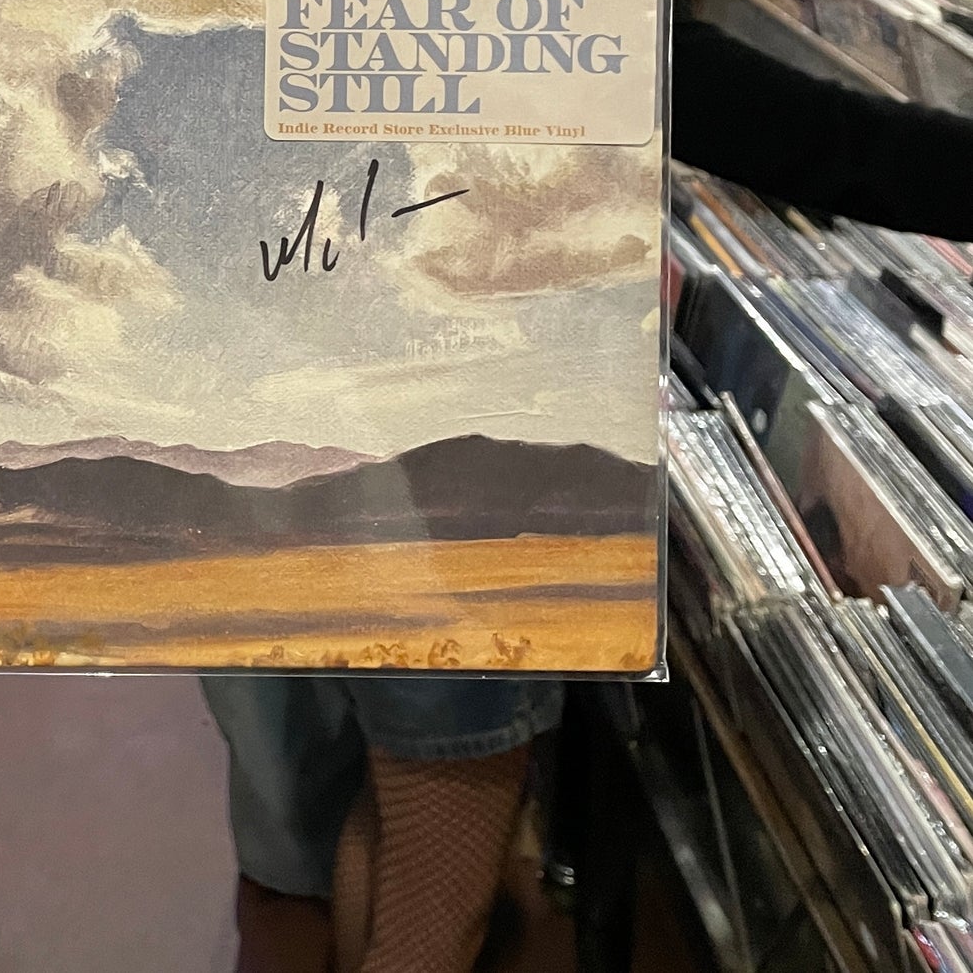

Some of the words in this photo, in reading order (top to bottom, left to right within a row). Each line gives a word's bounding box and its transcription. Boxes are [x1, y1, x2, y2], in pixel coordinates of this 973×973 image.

[279, 31, 630, 74] STANDING
[279, 72, 481, 114] STILL
[278, 122, 318, 134] Indie
[323, 123, 378, 134] Record
[383, 123, 424, 135] Store
[429, 124, 499, 136] Exclusive
[504, 125, 540, 136] Blue
[543, 125, 585, 138] Vinyl
